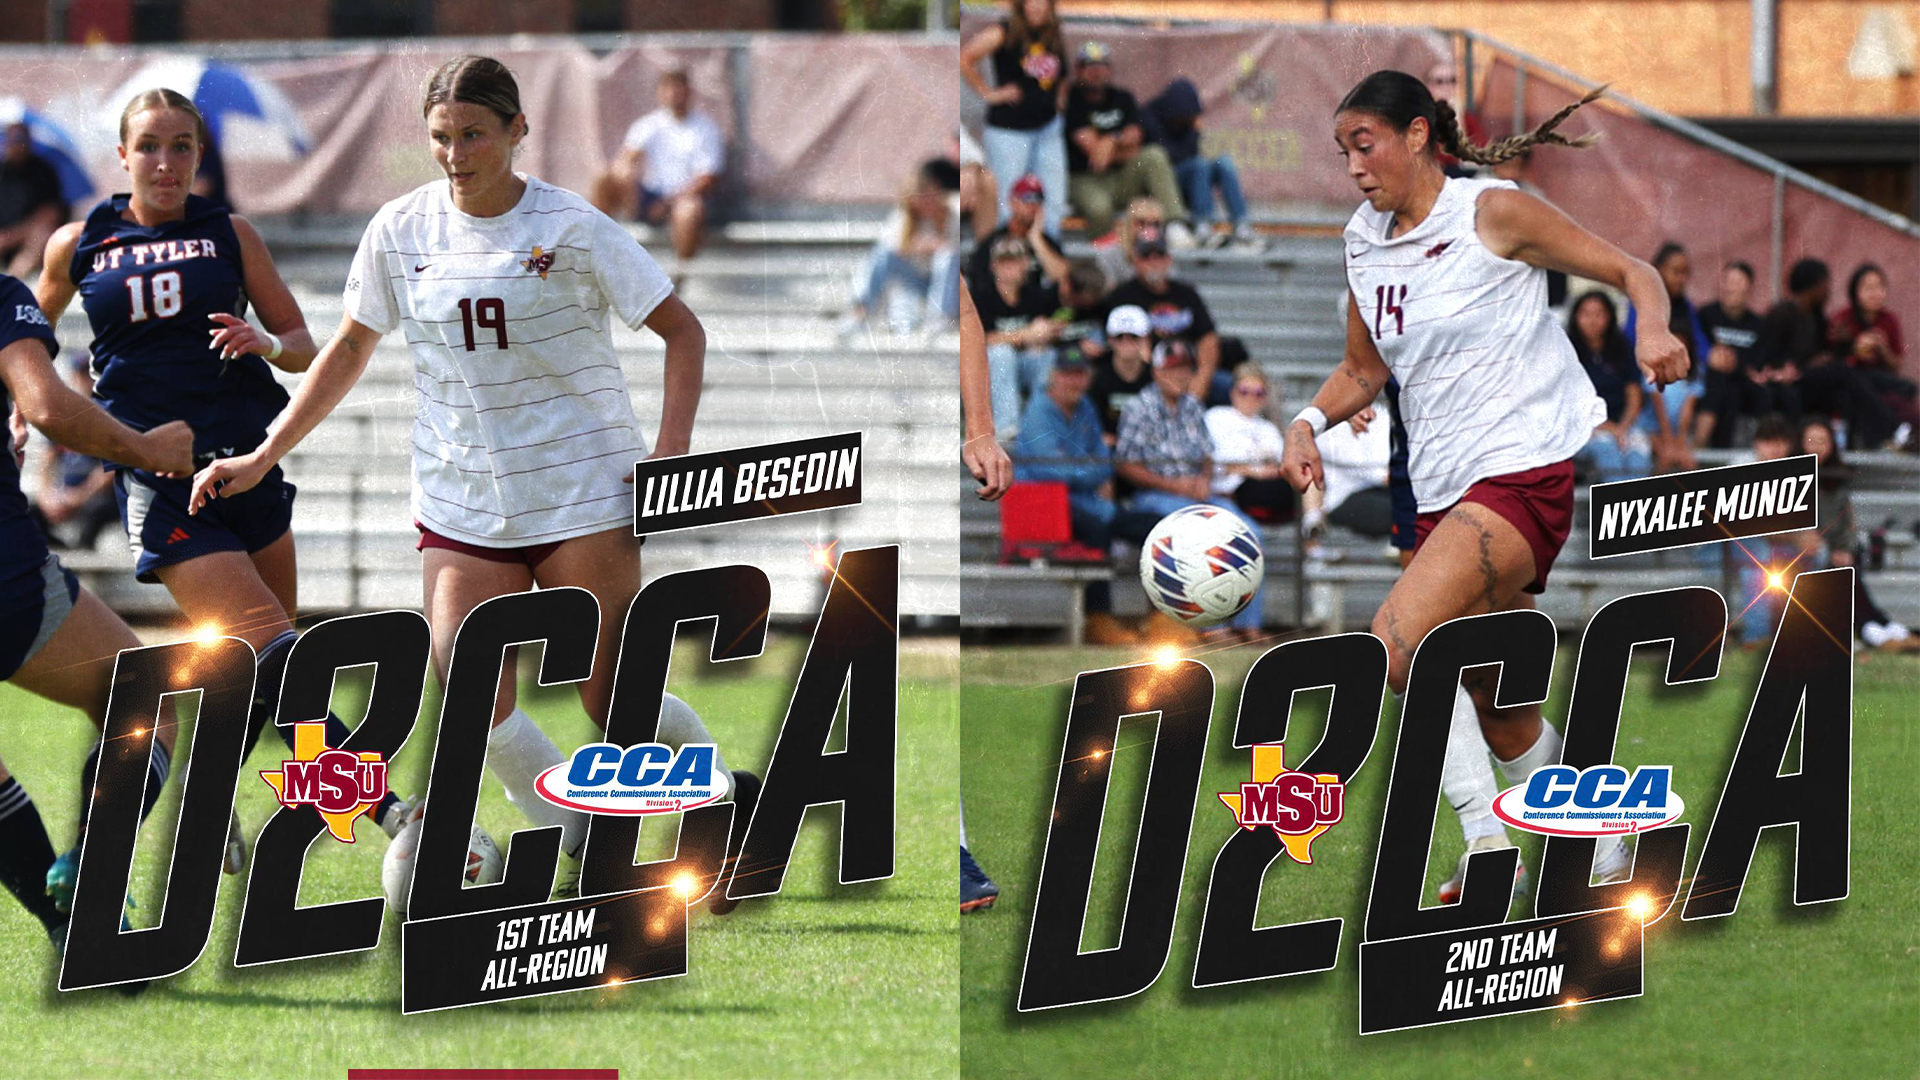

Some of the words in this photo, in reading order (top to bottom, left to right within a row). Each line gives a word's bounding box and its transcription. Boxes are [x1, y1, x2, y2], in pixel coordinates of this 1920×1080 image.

[92, 247, 124, 273] UT
[132, 239, 217, 266] TYLER
[125, 271, 183, 323] 18
[1376, 284, 1407, 339] 14
[457, 297, 509, 351] 19
